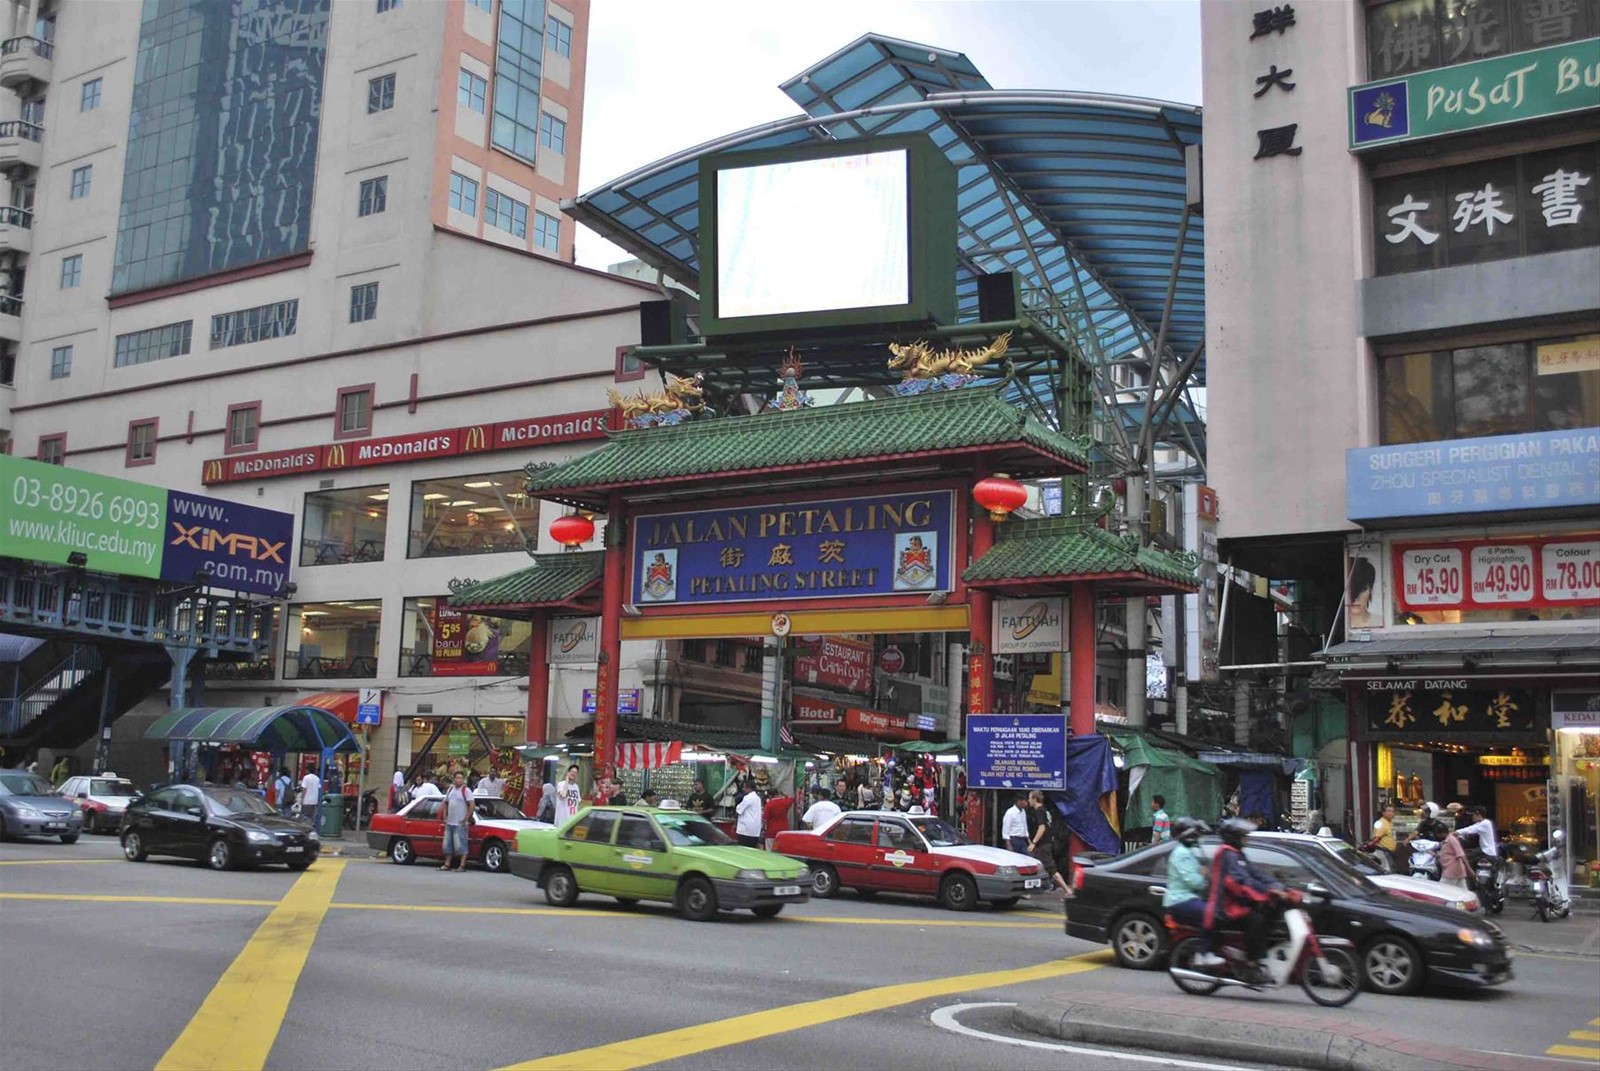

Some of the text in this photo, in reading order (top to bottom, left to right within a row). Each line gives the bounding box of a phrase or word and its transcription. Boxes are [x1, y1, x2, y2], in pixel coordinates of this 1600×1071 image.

[1385, 168, 1590, 245] 文殊書
[233, 451, 315, 474] McDonald's
[359, 436, 451, 460] McDonald's
[501, 417, 604, 442] McDonald's
[1369, 450, 1441, 470] SURGERI
[1449, 440, 1542, 464] PERGIGIAN
[1371, 474, 1415, 491] ZHOU
[1422, 466, 1511, 487] SPECIALIST
[1518, 461, 1582, 480] DENTAL
[13, 476, 160, 530] 03-8926 6993
[173, 497, 229, 522] www.
[648, 500, 931, 545] JALAN PETALING
[9, 518, 156, 564] www.kliuc.edu.my
[1556, 548, 1591, 558] Colour
[1414, 554, 1450, 565] Dry Cut
[1478, 555, 1525, 565] Highlighting
[204, 560, 285, 591] com.my
[690, 568, 878, 595] PETALING STREET
[1407, 567, 1459, 595] RM 15.90
[1474, 563, 1530, 593] RM 49.90
[1546, 579, 1557, 590] RM
[1001, 641, 1019, 649] GROUP
[1029, 640, 1060, 648] COMPANIES
[1367, 680, 1467, 690] SELAMAT DATANG
[800, 706, 835, 719] Hotel
[1563, 712, 1595, 722] KEDAI
